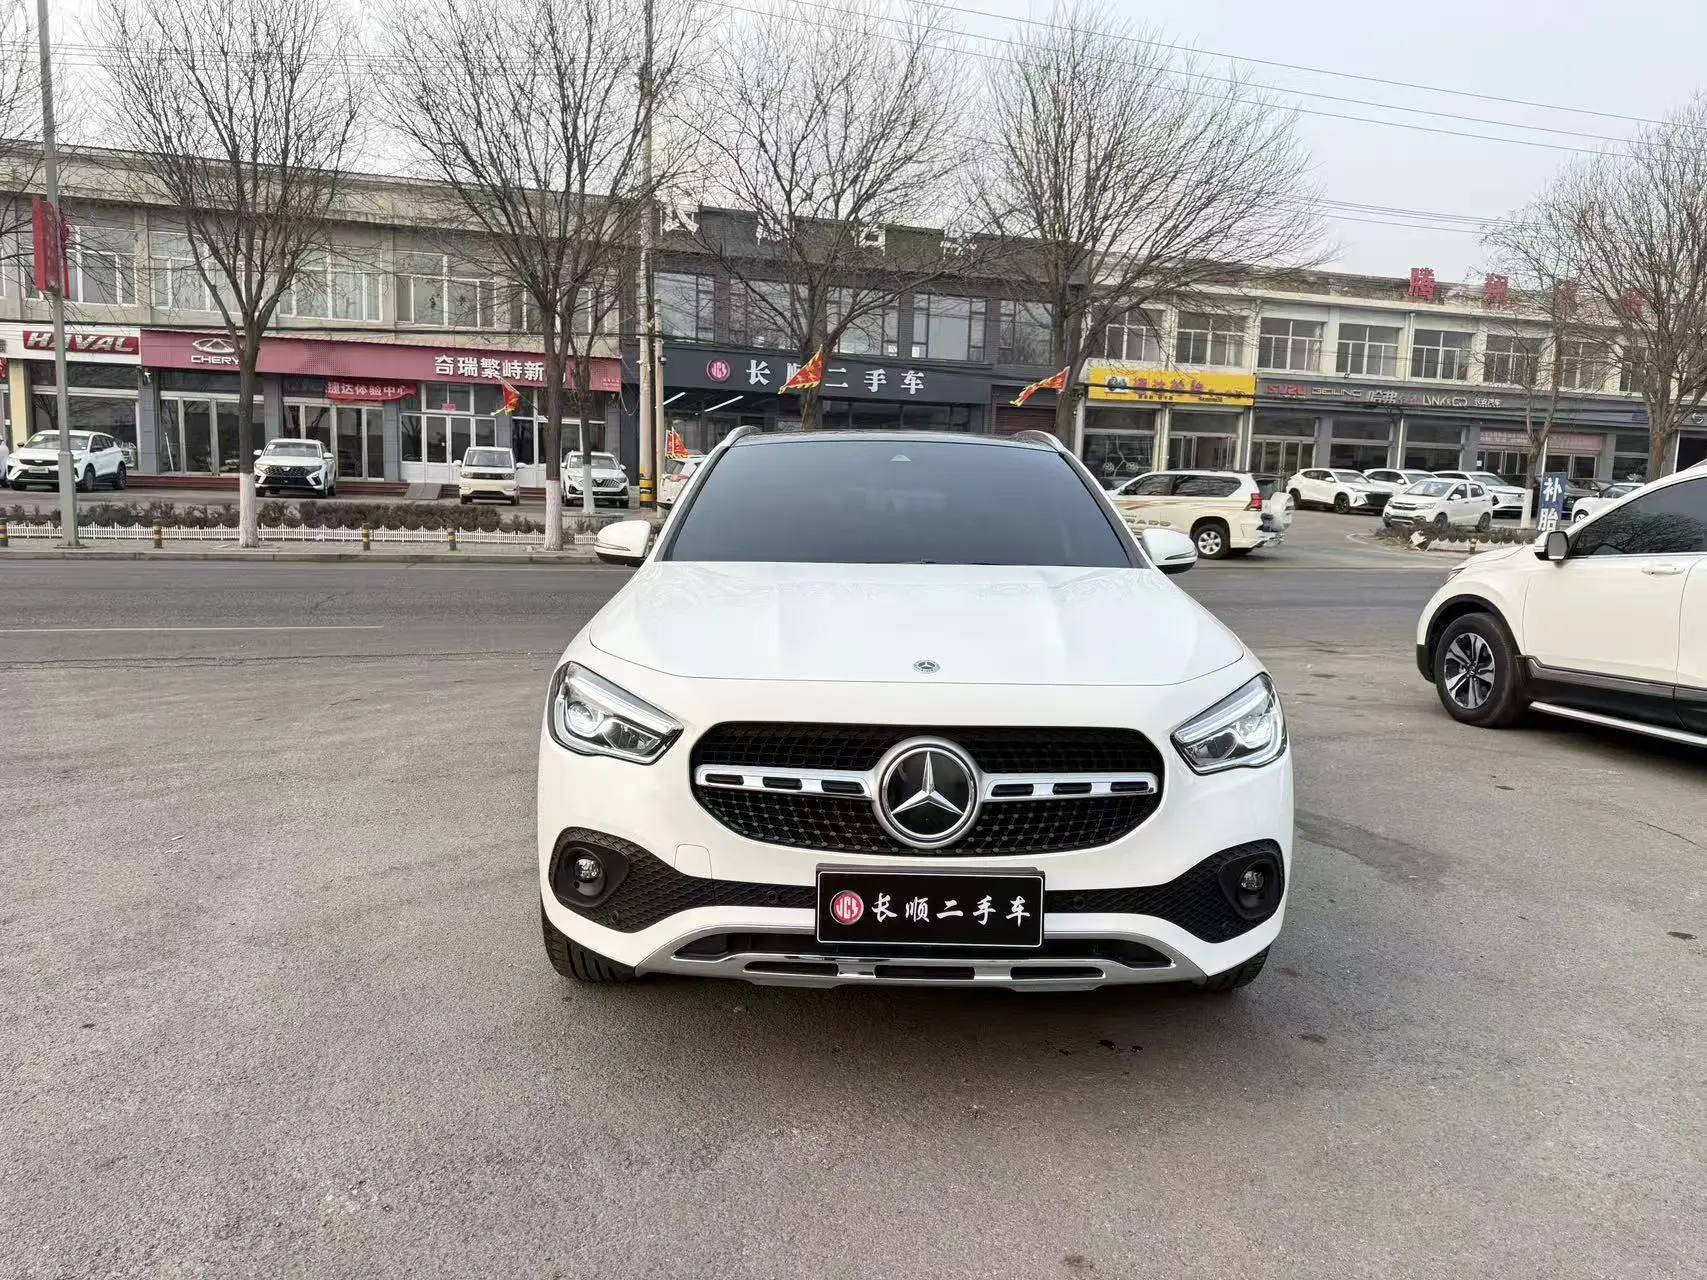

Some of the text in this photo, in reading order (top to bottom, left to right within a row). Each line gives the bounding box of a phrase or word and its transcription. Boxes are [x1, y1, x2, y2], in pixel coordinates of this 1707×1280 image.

[191, 355, 240, 364] CHERY
[1537, 477, 1563, 531] 补胎
[871, 892, 1031, 928] 长顺二手车
